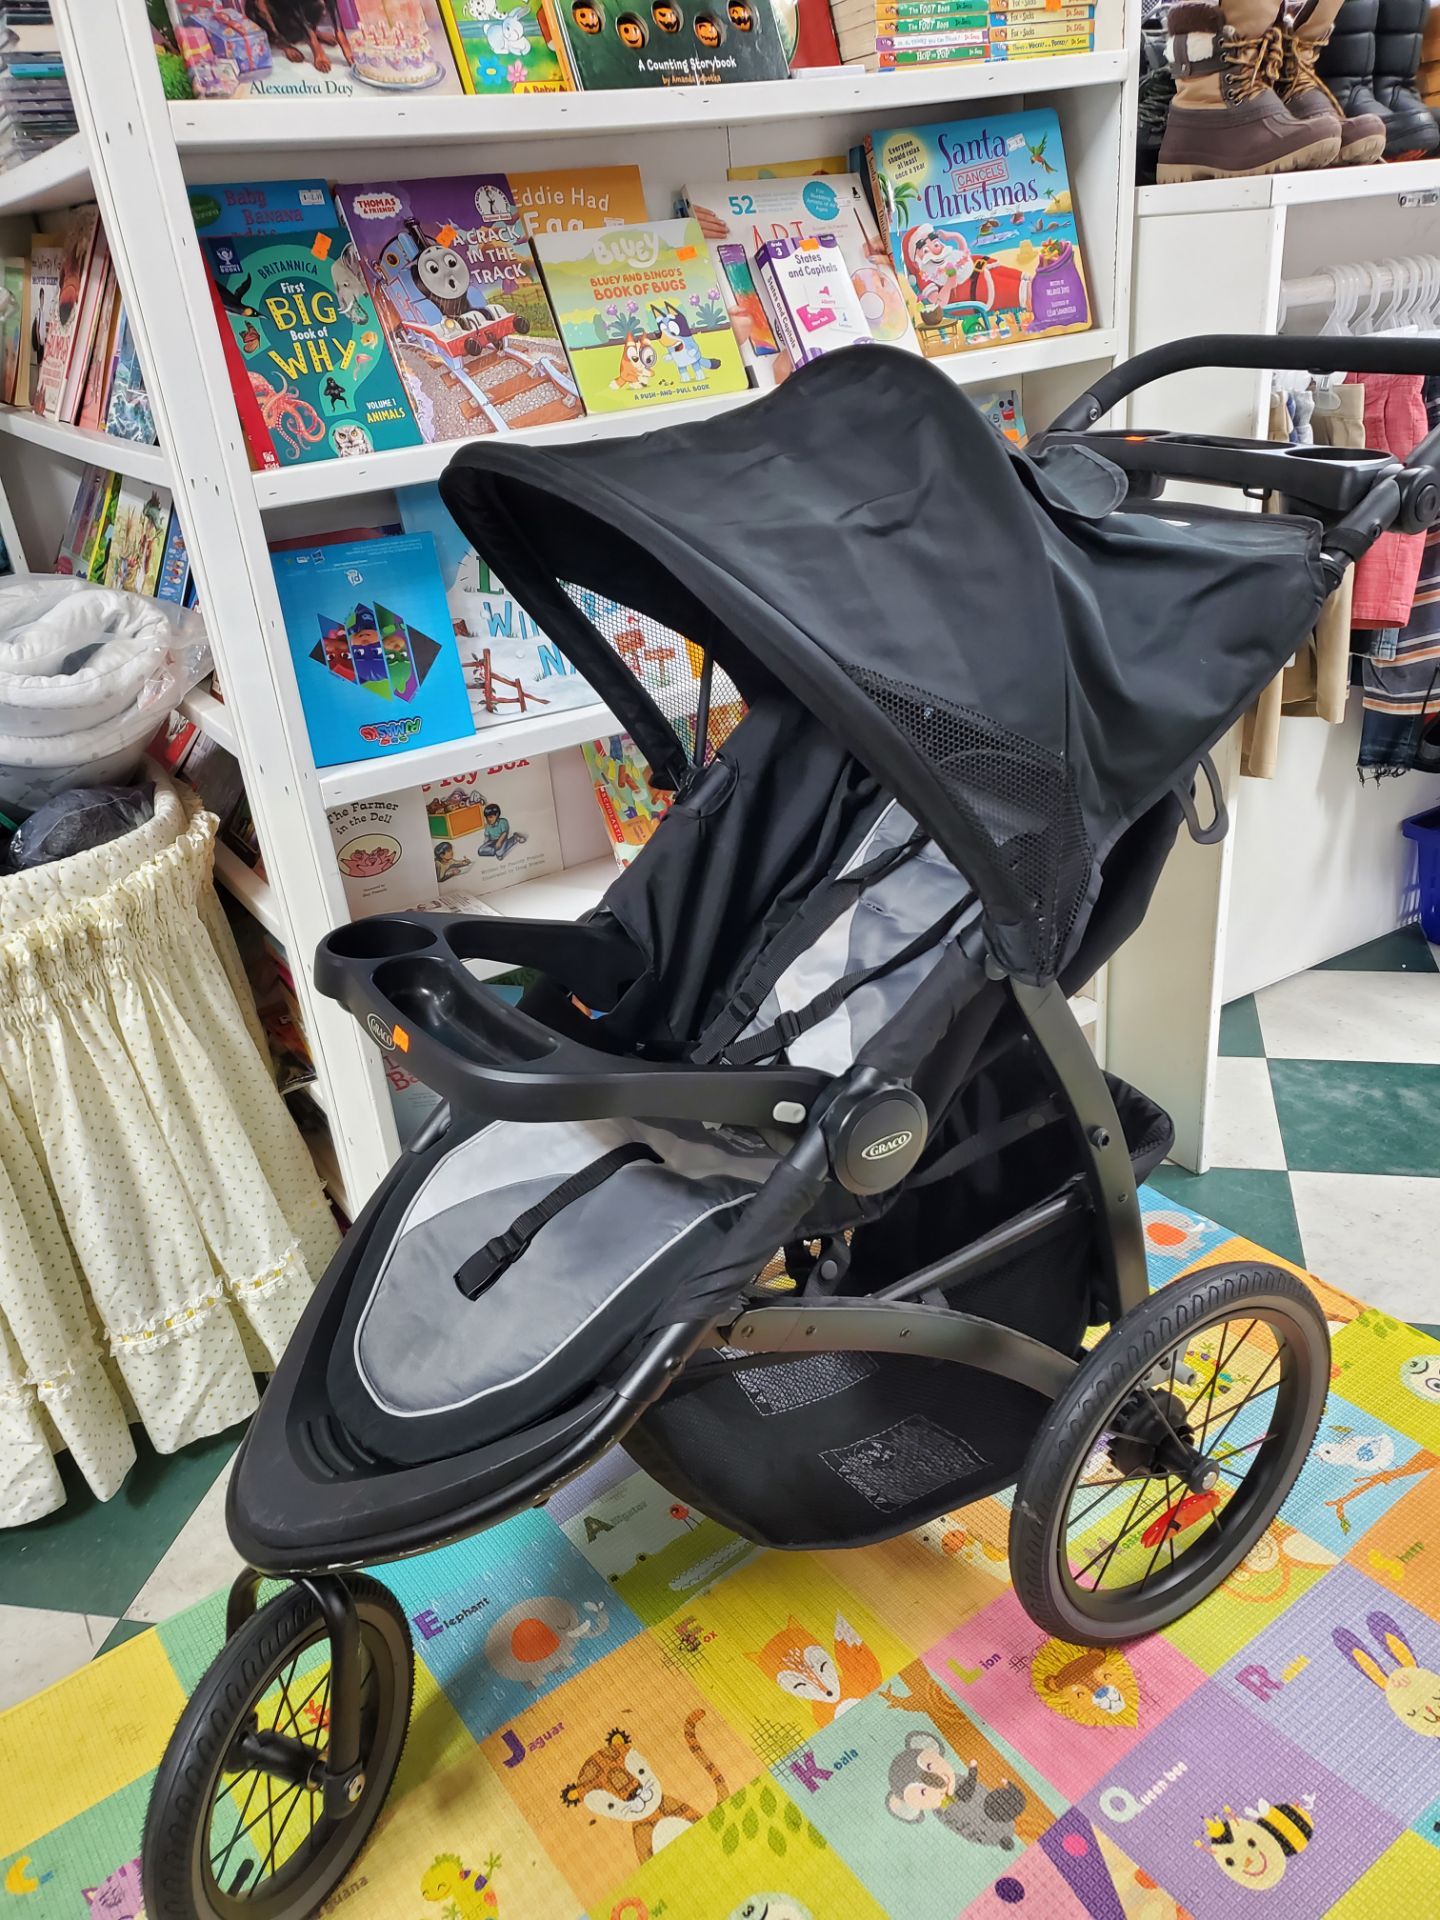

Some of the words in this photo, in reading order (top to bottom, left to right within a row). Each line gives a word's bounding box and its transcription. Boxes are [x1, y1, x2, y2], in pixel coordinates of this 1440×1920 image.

[638, 59, 645, 71] A
[647, 58, 688, 73] Counting
[690, 56, 737, 72] Storybook
[250, 80, 322, 95] Alexandra
[325, 81, 354, 97] Day
[938, 128, 1009, 174] Santa
[957, 164, 1005, 186] CANCELS
[357, 198, 396, 208] THOMAS
[571, 187, 609, 212] Had
[728, 195, 757, 215] 52
[924, 178, 1039, 220] Christmas
[453, 234, 465, 247] A
[467, 225, 520, 245] CRACK
[466, 248, 484, 264] IN
[486, 247, 517, 263] THE
[795, 254, 822, 265] States
[258, 261, 318, 279] BRITANNICA
[471, 263, 526, 284] TRACK
[590, 275, 621, 287] BLUEY
[623, 272, 642, 283] AND
[643, 268, 682, 281] BINGO'S
[788, 267, 804, 278] and
[805, 262, 838, 277] Capitals
[280, 283, 306, 294] First
[594, 286, 633, 301] BOOK
[633, 283, 649, 296] OF
[651, 279, 687, 293] BUGS
[265, 291, 337, 331] BIG
[290, 328, 316, 341] Book
[318, 326, 328, 337] of
[268, 338, 356, 380] WHY
[366, 400, 391, 410] VOLUME
[367, 407, 406, 424] ANIMALS
[327, 808, 350, 824] The
[351, 801, 399, 813] Farmer
[602, 792, 624, 842] SCHOLASTIC
[336, 825, 348, 835] in
[349, 815, 367, 826] the
[370, 812, 393, 824] Dell
[370, 1018, 393, 1047] GRACO
[869, 1134, 907, 1156] GRACO
[946, 1653, 1002, 1686] Lion
